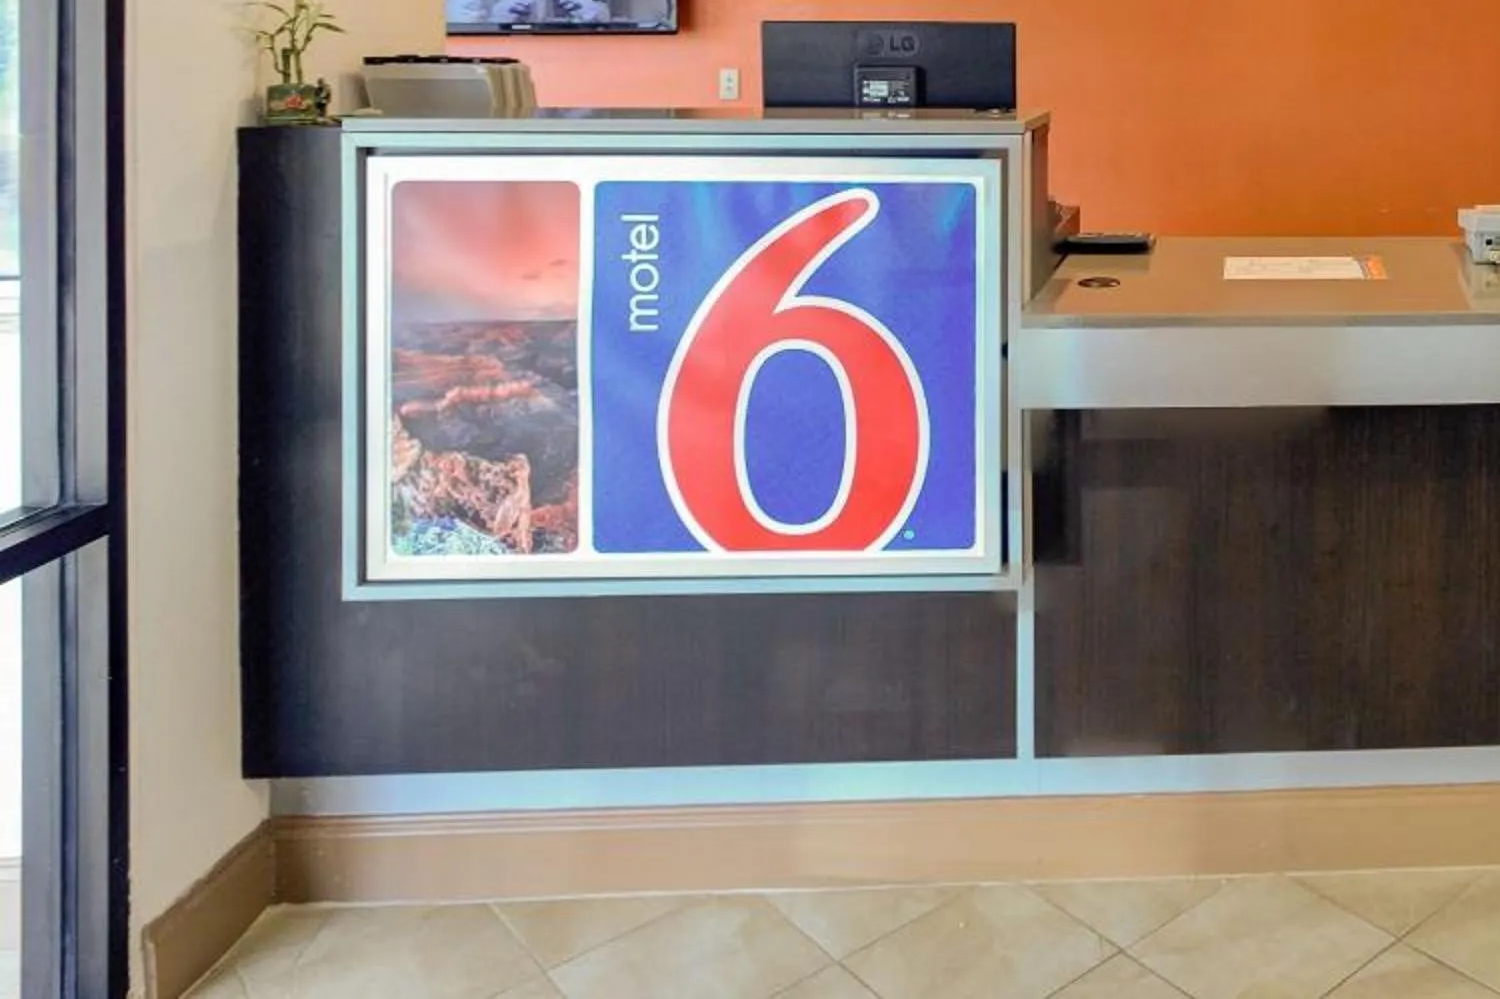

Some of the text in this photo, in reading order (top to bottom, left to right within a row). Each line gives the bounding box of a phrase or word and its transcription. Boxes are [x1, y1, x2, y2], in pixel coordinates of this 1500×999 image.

[889, 35, 916, 52] LG
[620, 214, 660, 332] motel
[656, 187, 931, 553] 6
